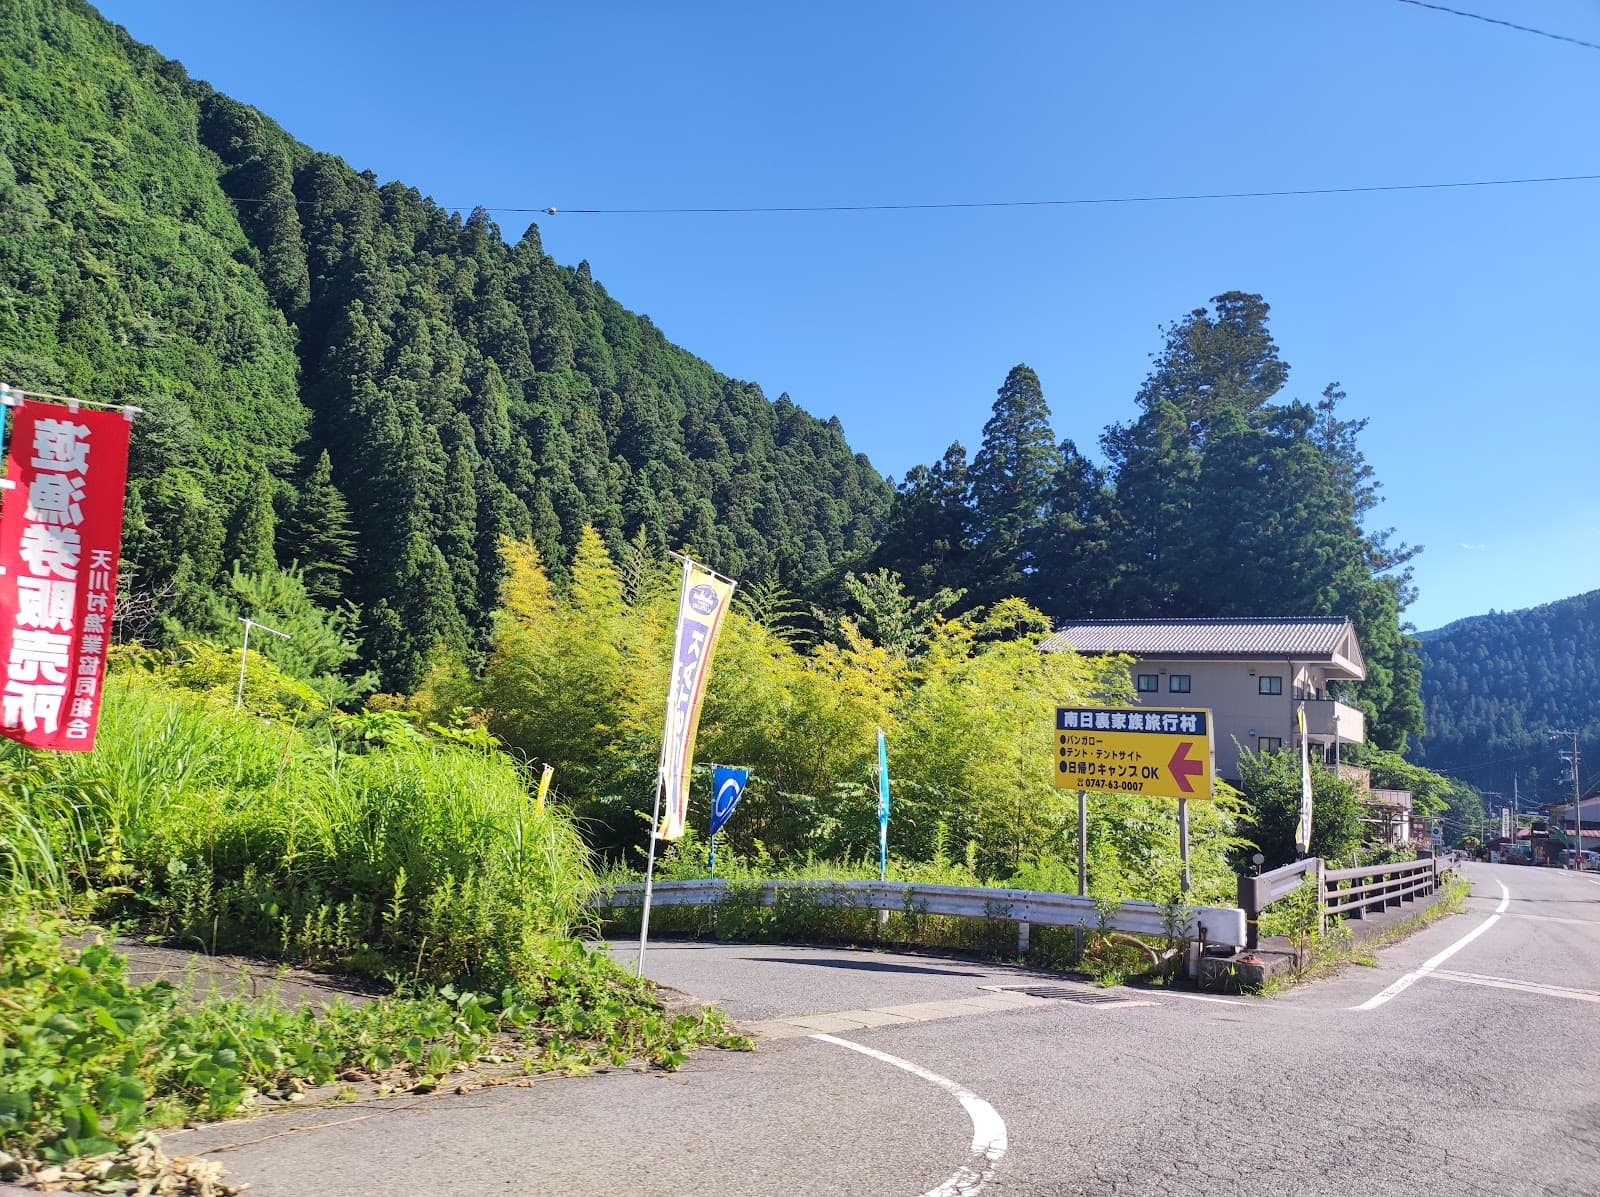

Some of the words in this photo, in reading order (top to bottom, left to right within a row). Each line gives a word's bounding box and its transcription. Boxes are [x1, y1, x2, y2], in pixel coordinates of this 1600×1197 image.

[1064, 711, 1196, 732] 南日裏家族旅行村
[1066, 735, 1103, 746] バンガロー
[1066, 747, 1142, 761] テント・テントサイト
[1141, 766, 1160, 780] OK
[1085, 778, 1144, 791] 0747-63-0007
